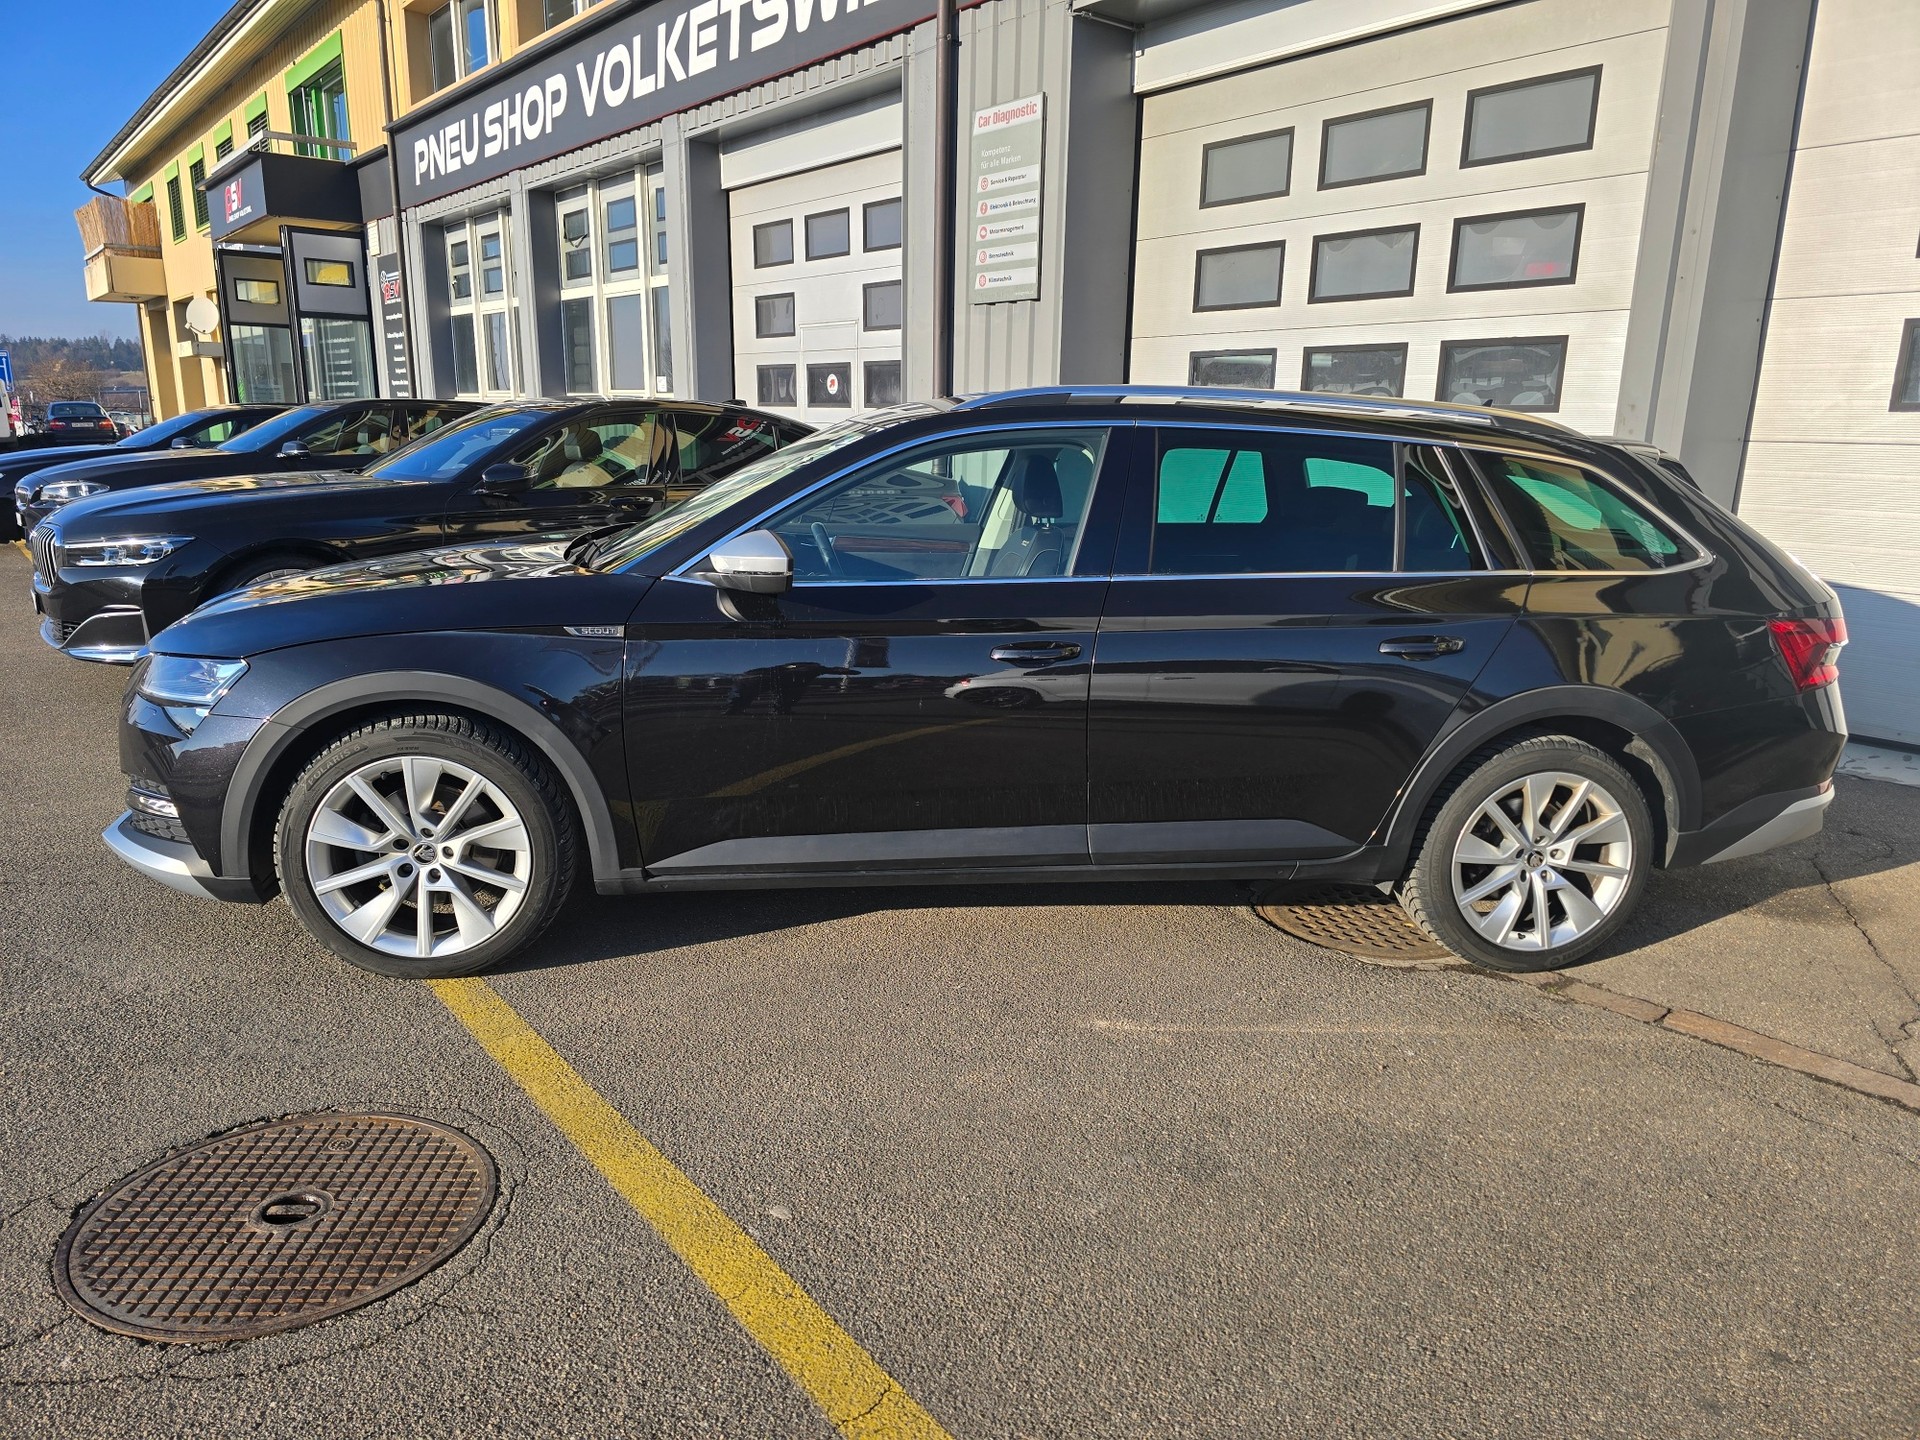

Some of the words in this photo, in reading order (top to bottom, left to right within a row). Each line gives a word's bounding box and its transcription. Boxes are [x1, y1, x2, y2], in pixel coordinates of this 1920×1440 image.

[414, 116, 480, 186] PNEU
[483, 73, 568, 159] SHOP
[576, 0, 879, 118] VOLKETS
[978, 115, 991, 128] Car
[993, 101, 1037, 124] Diagnostic
[981, 160, 989, 169] für
[990, 158, 999, 167] alle
[1001, 155, 1022, 165] Marken
[982, 145, 1011, 157] Kompetenz
[308, 748, 351, 784] POLARIS
